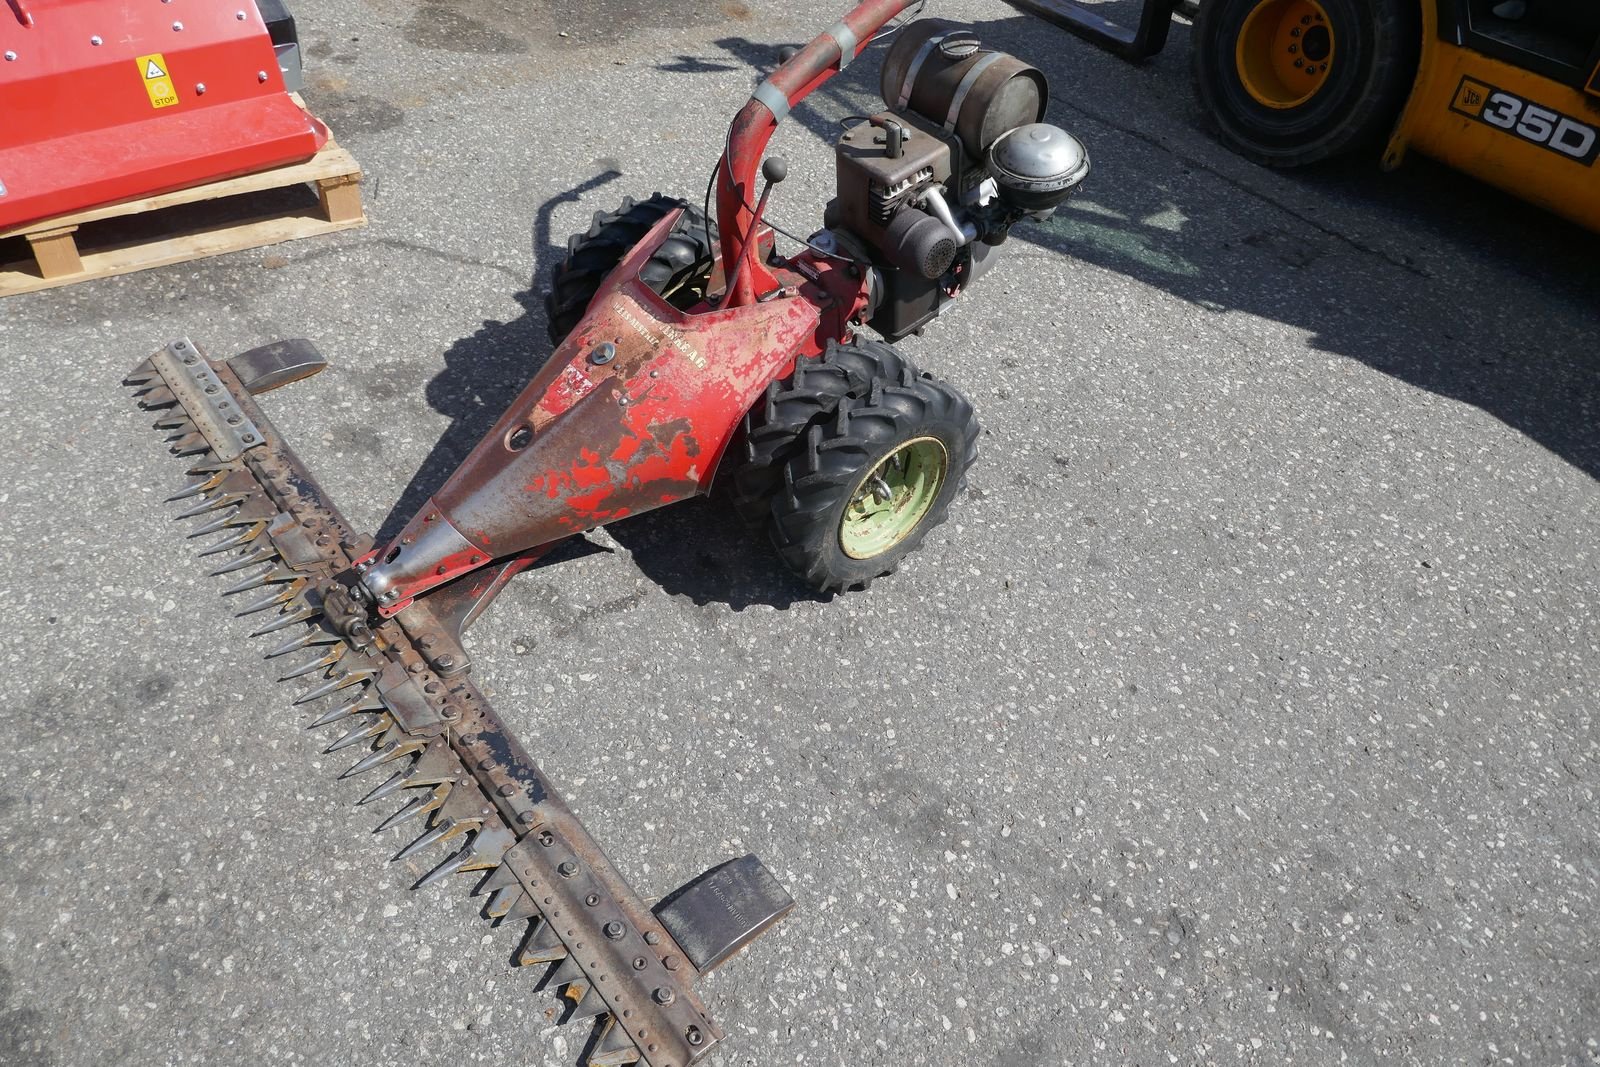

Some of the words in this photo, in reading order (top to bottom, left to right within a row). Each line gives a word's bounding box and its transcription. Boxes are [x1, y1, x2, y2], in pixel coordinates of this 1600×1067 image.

[154, 96, 175, 106] STOP
[1464, 90, 1480, 105] JCB
[1483, 92, 1596, 158] 35D
